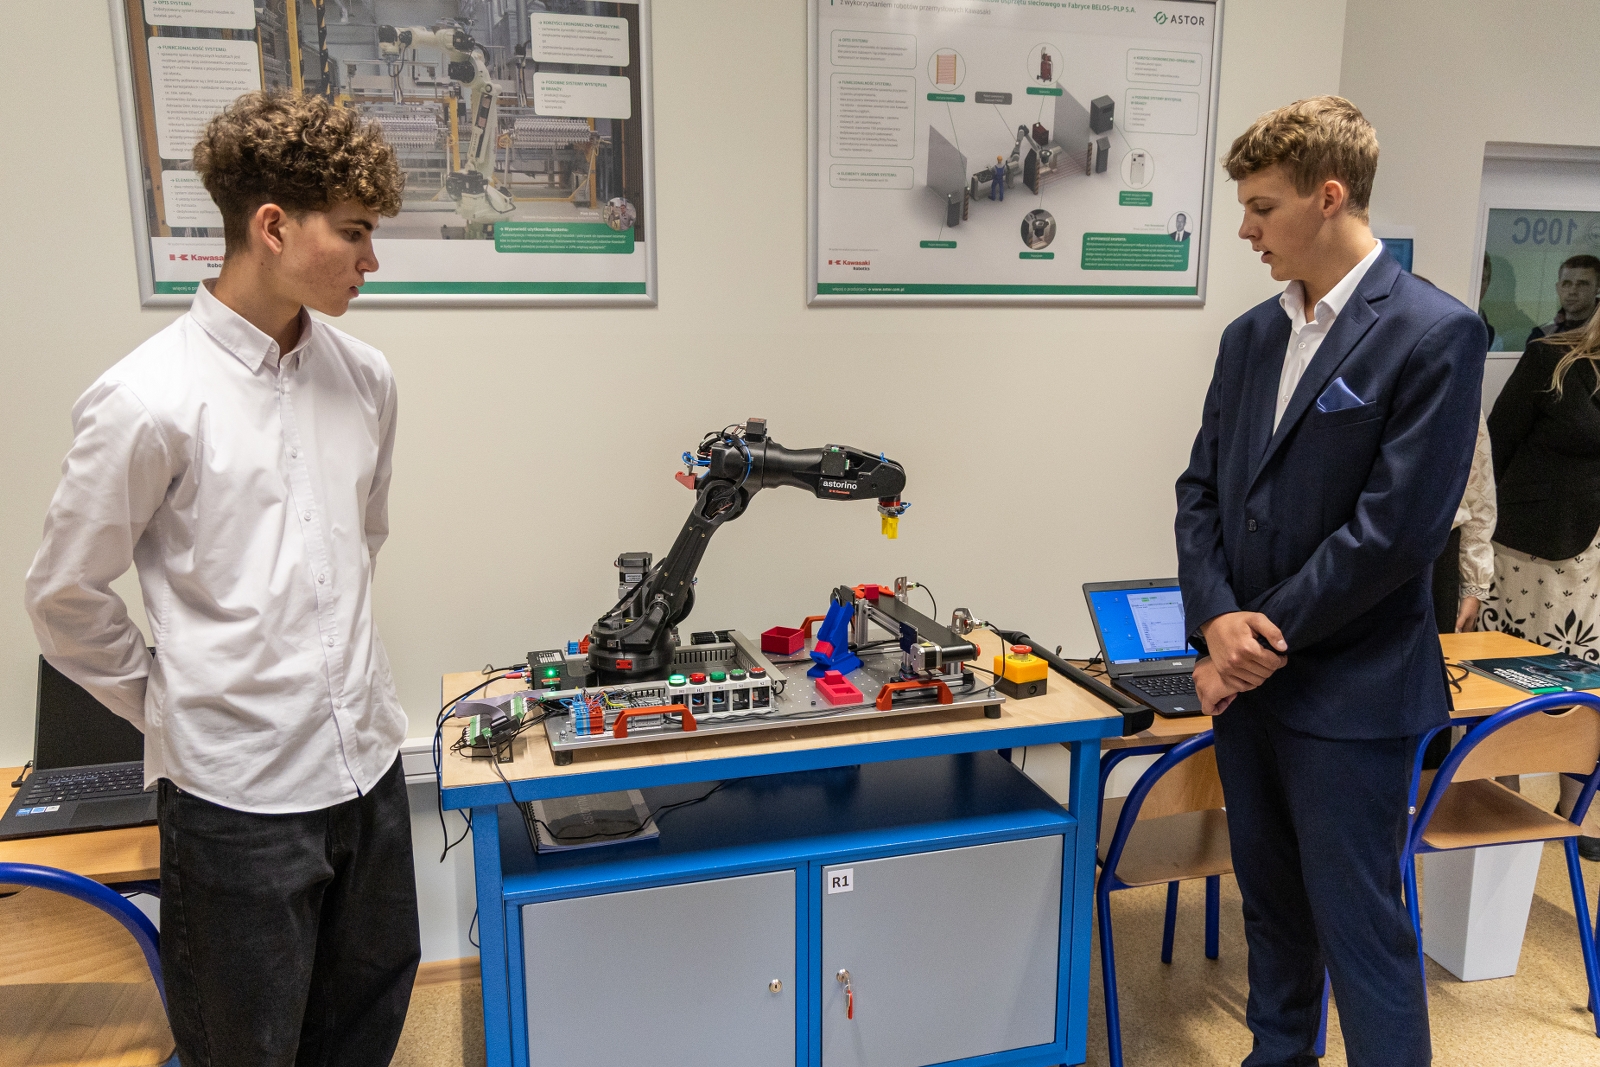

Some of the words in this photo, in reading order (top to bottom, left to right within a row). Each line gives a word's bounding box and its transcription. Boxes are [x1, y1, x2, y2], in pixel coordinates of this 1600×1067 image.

[844, 0, 893, 9] wykorzystaniem
[893, 3, 918, 11] robotów
[964, 7, 991, 15] Kawasaki
[1027, 0, 1061, 9] sieciowego
[1068, 3, 1091, 11] Fabryce
[1170, 14, 1205, 26] ASTOR
[823, 481, 857, 490] astorino
[832, 875, 849, 889] R1
